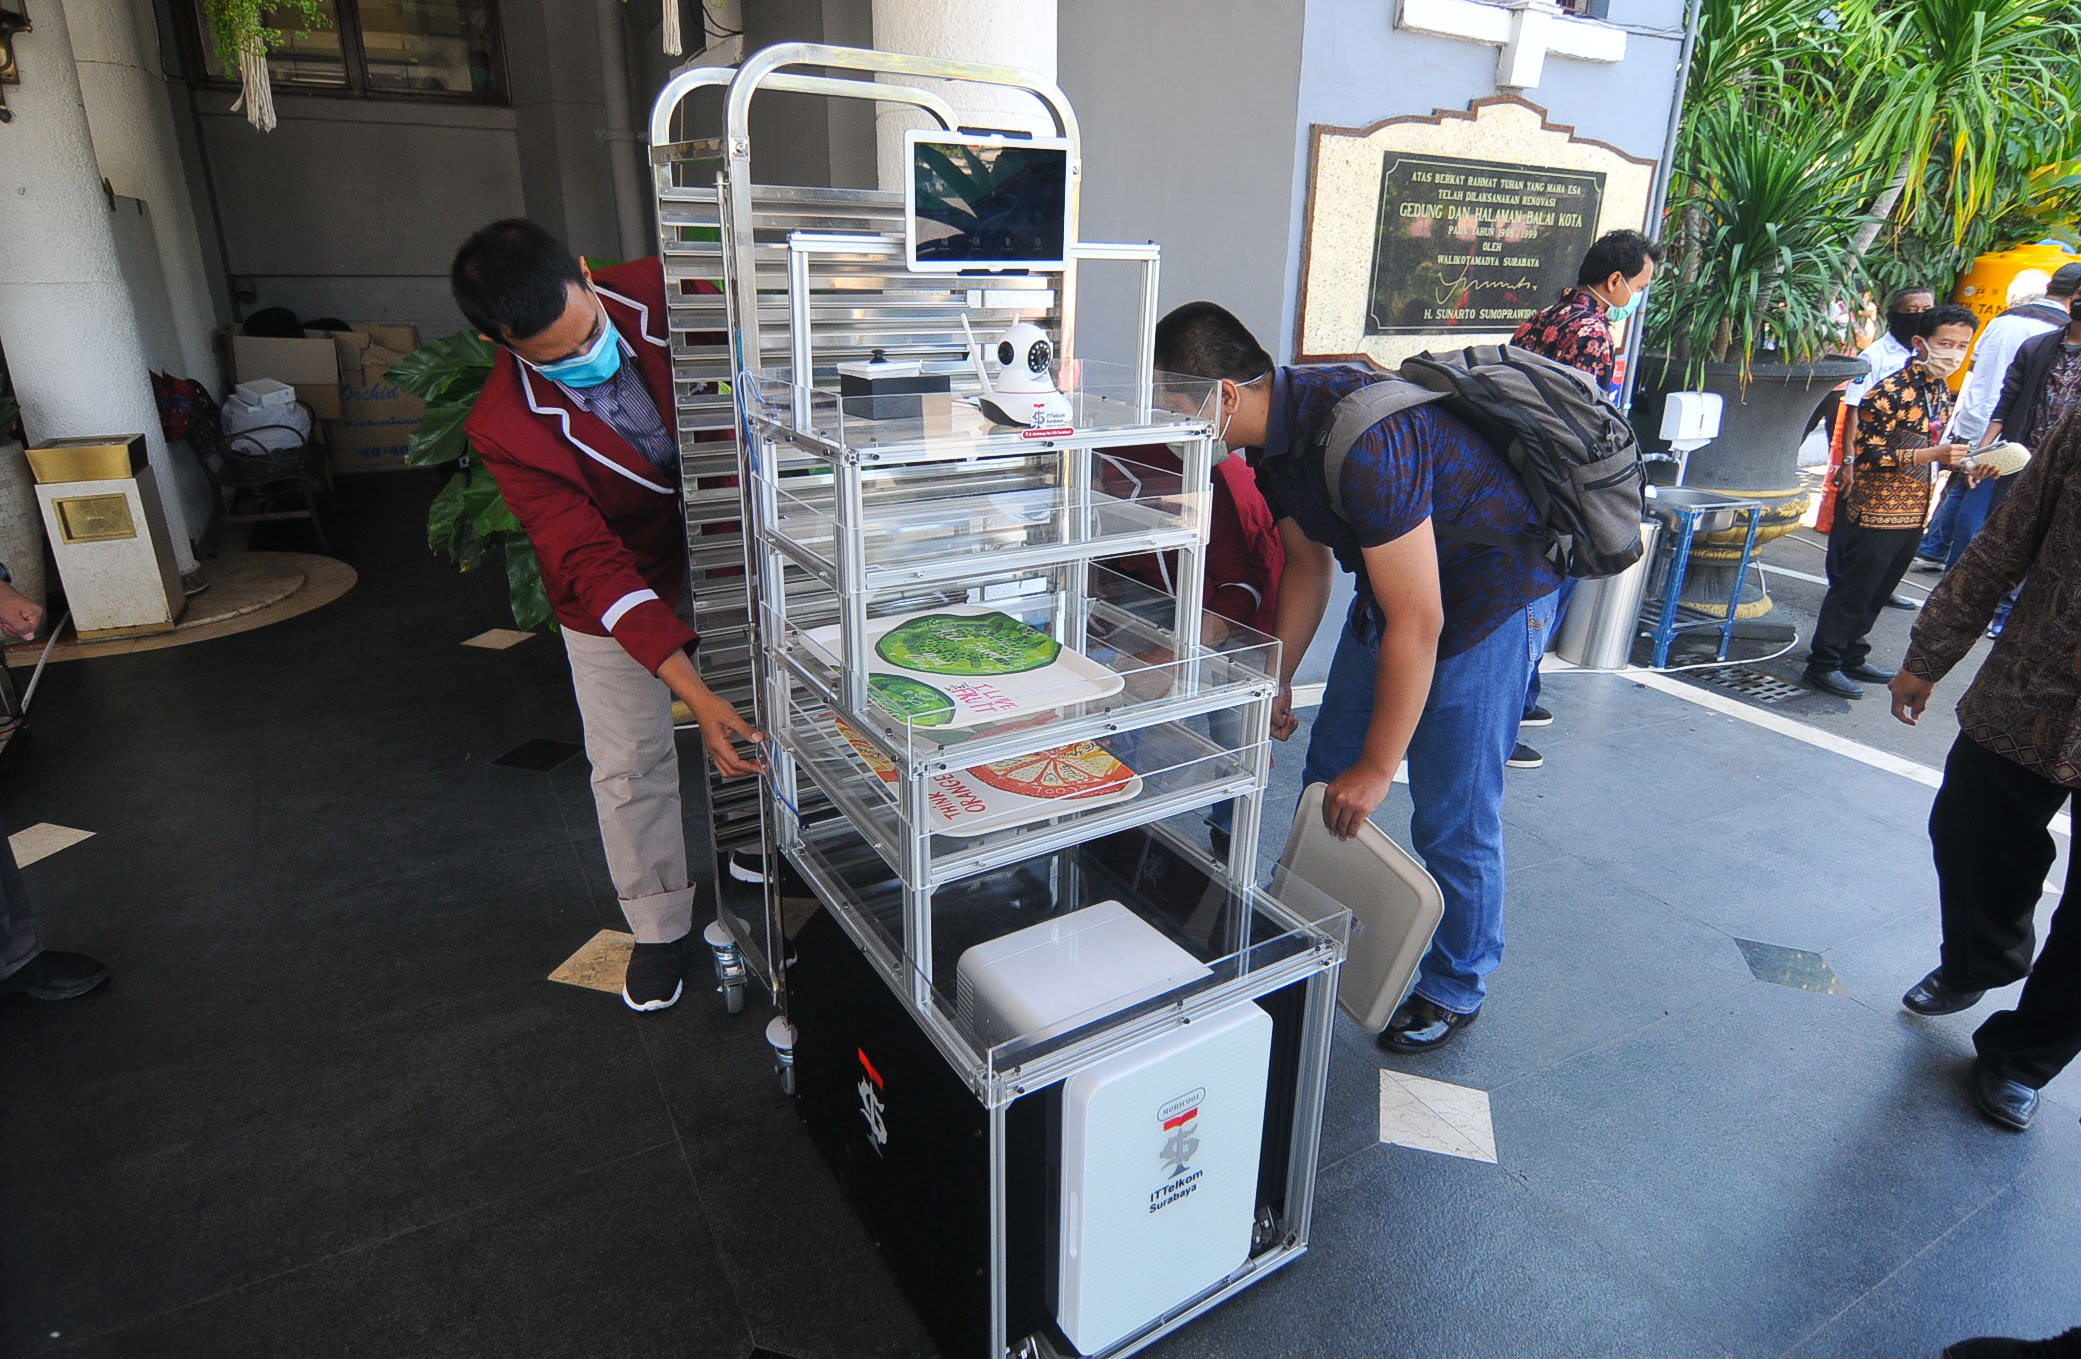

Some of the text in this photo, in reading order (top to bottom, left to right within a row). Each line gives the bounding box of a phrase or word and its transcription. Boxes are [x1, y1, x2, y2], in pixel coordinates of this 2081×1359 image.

[1411, 171, 1581, 195] ATAS BERKAT RAHMAT TUHAN YANG MAHA ESA
[1438, 189, 1557, 207] TELAH DILAKSANAKAN RENOVASI
[1400, 202, 1582, 228] GEDUNG DAN HALAMAN BALAI KOTA
[1482, 241, 1502, 252] OLEH
[1437, 255, 1540, 268] WALIKOTAMADYA SURABAYA
[1424, 309, 1432, 319] H.
[1436, 309, 1476, 320] SUNARTO
[933, 773, 986, 813] ORANGE
[928, 791, 961, 821] THINK
[1150, 1169, 1203, 1203] ITTelkom
[1149, 1184, 1197, 1214] Surabaya
